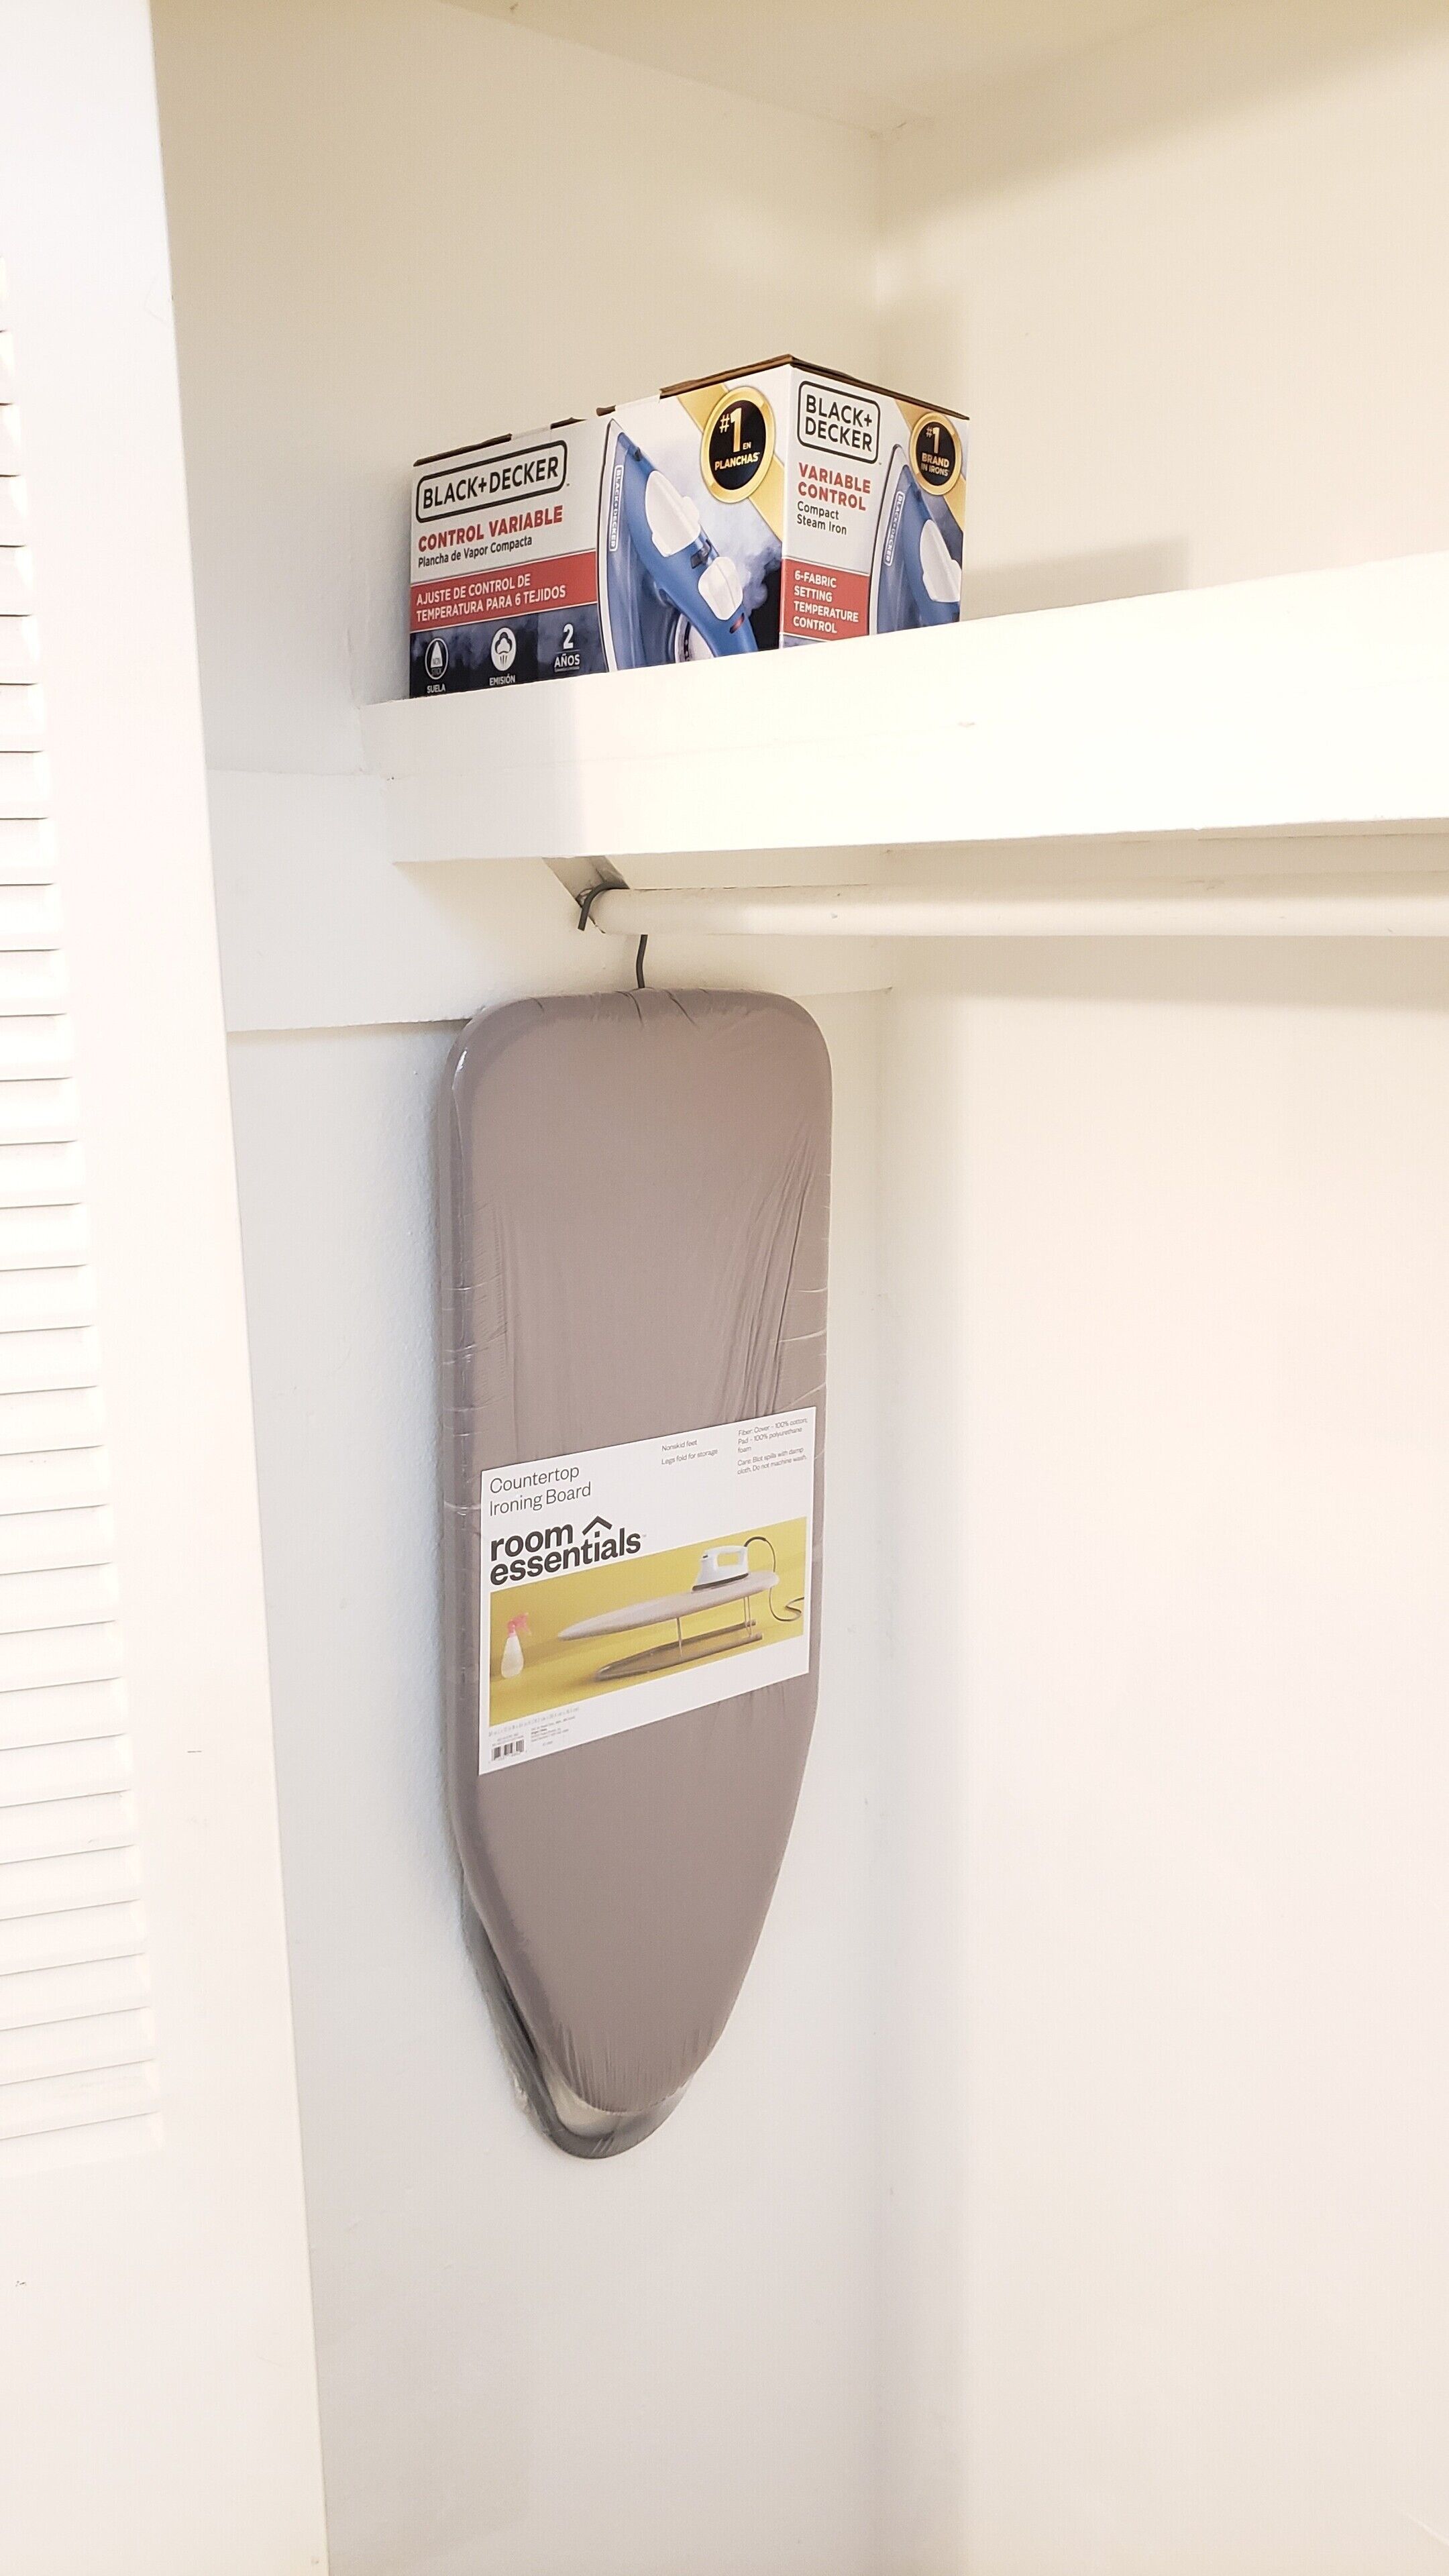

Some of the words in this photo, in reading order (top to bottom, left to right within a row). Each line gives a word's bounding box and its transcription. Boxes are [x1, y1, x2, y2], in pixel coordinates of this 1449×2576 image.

[806, 394, 872, 427] BLACK+
[719, 408, 742, 452] #1
[805, 417, 872, 451] DECKER
[926, 427, 939, 453] #1
[714, 452, 759, 470] PLANCHAS
[921, 463, 928, 471] IN
[929, 465, 948, 476] IRONS
[922, 453, 949, 468] BRAND
[423, 456, 558, 508] BLACK+DECKER
[799, 462, 871, 494] VARIABLE
[798, 482, 866, 511] CONTROL
[798, 501, 839, 521] Compact
[419, 524, 484, 551] CONTROL
[489, 505, 563, 537] VARIABLE
[797, 514, 826, 530] Steam
[829, 522, 847, 535] Iron
[419, 553, 448, 568] Plancha
[451, 550, 461, 561] de
[464, 545, 488, 559] Vapor
[490, 536, 532, 553] Compacta
[417, 589, 451, 606] AJUSTE
[453, 586, 466, 598] DE
[468, 578, 515, 596] CONTROL
[518, 574, 531, 588] DE
[794, 570, 837, 588] 6-FABRIC
[417, 598, 484, 622] TEMPERATURA
[486, 595, 512, 610] PARA
[515, 593, 521, 605] 6
[523, 585, 566, 603] TEJIDOS
[794, 586, 833, 602] SETTING
[793, 616, 837, 633] CONTROL
[794, 601, 859, 623] TEMPERATURE
[564, 624, 574, 649] 2
[554, 653, 580, 667] AÑOS
[427, 684, 445, 694] SUELA
[490, 675, 516, 686] EMISIÓN
[769, 1428, 802, 1439] polyurethane
[662, 1442, 685, 1451] Nonskid
[698, 1449, 718, 1458] storage
[490, 1466, 579, 1493] Countertop
[490, 1495, 543, 1516] Ironing
[546, 1481, 591, 1505] Board
[491, 1523, 573, 1562] room
[490, 1527, 641, 1585] essentials
